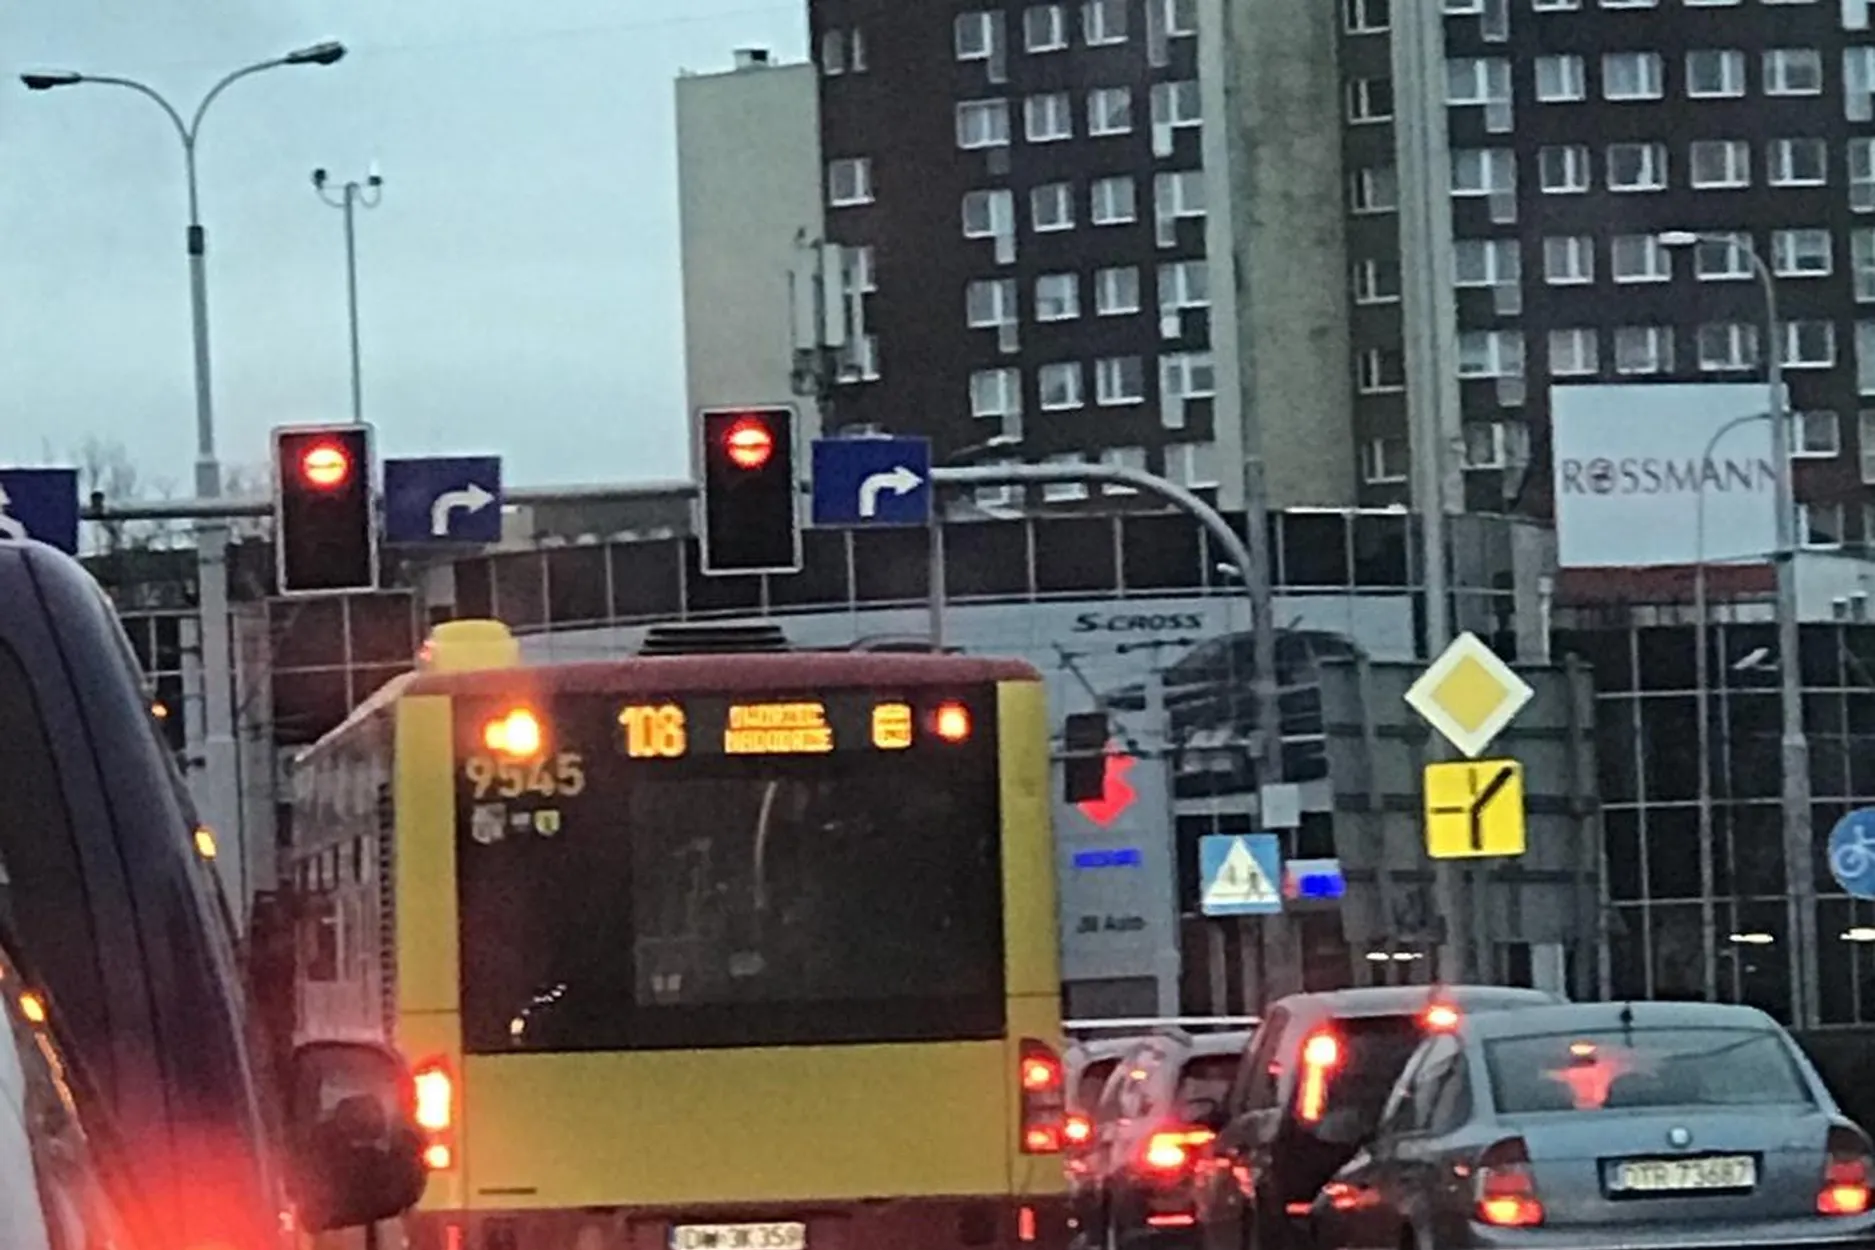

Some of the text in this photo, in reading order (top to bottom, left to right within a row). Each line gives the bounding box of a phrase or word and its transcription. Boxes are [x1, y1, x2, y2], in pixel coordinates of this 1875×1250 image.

[1561, 456, 1777, 495] ROSSMANN
[618, 704, 686, 757] 108
[465, 751, 586, 799] 9545
